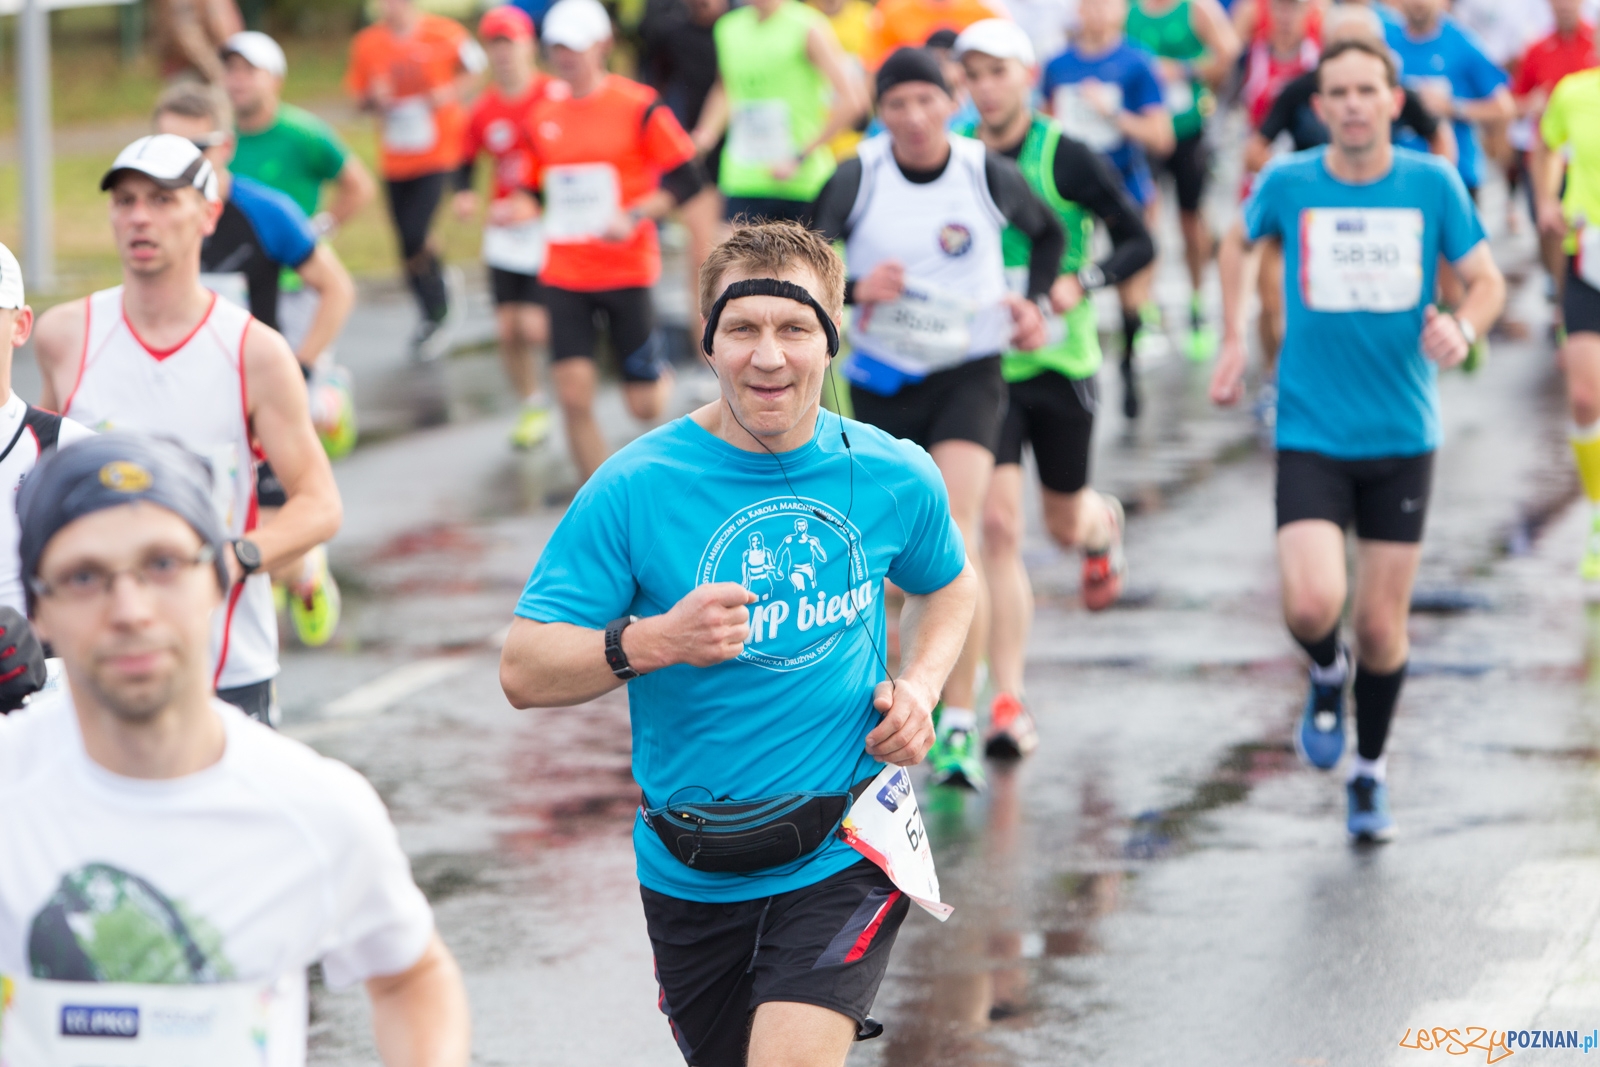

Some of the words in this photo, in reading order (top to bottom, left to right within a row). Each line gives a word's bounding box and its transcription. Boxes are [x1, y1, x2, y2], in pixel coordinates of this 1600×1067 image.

[1331, 243, 1400, 267] 5830
[708, 523, 736, 561] MEDYCZNY
[747, 504, 778, 519] KAROLA
[796, 580, 873, 632] biega
[784, 651, 817, 667] DRUŻYNA
